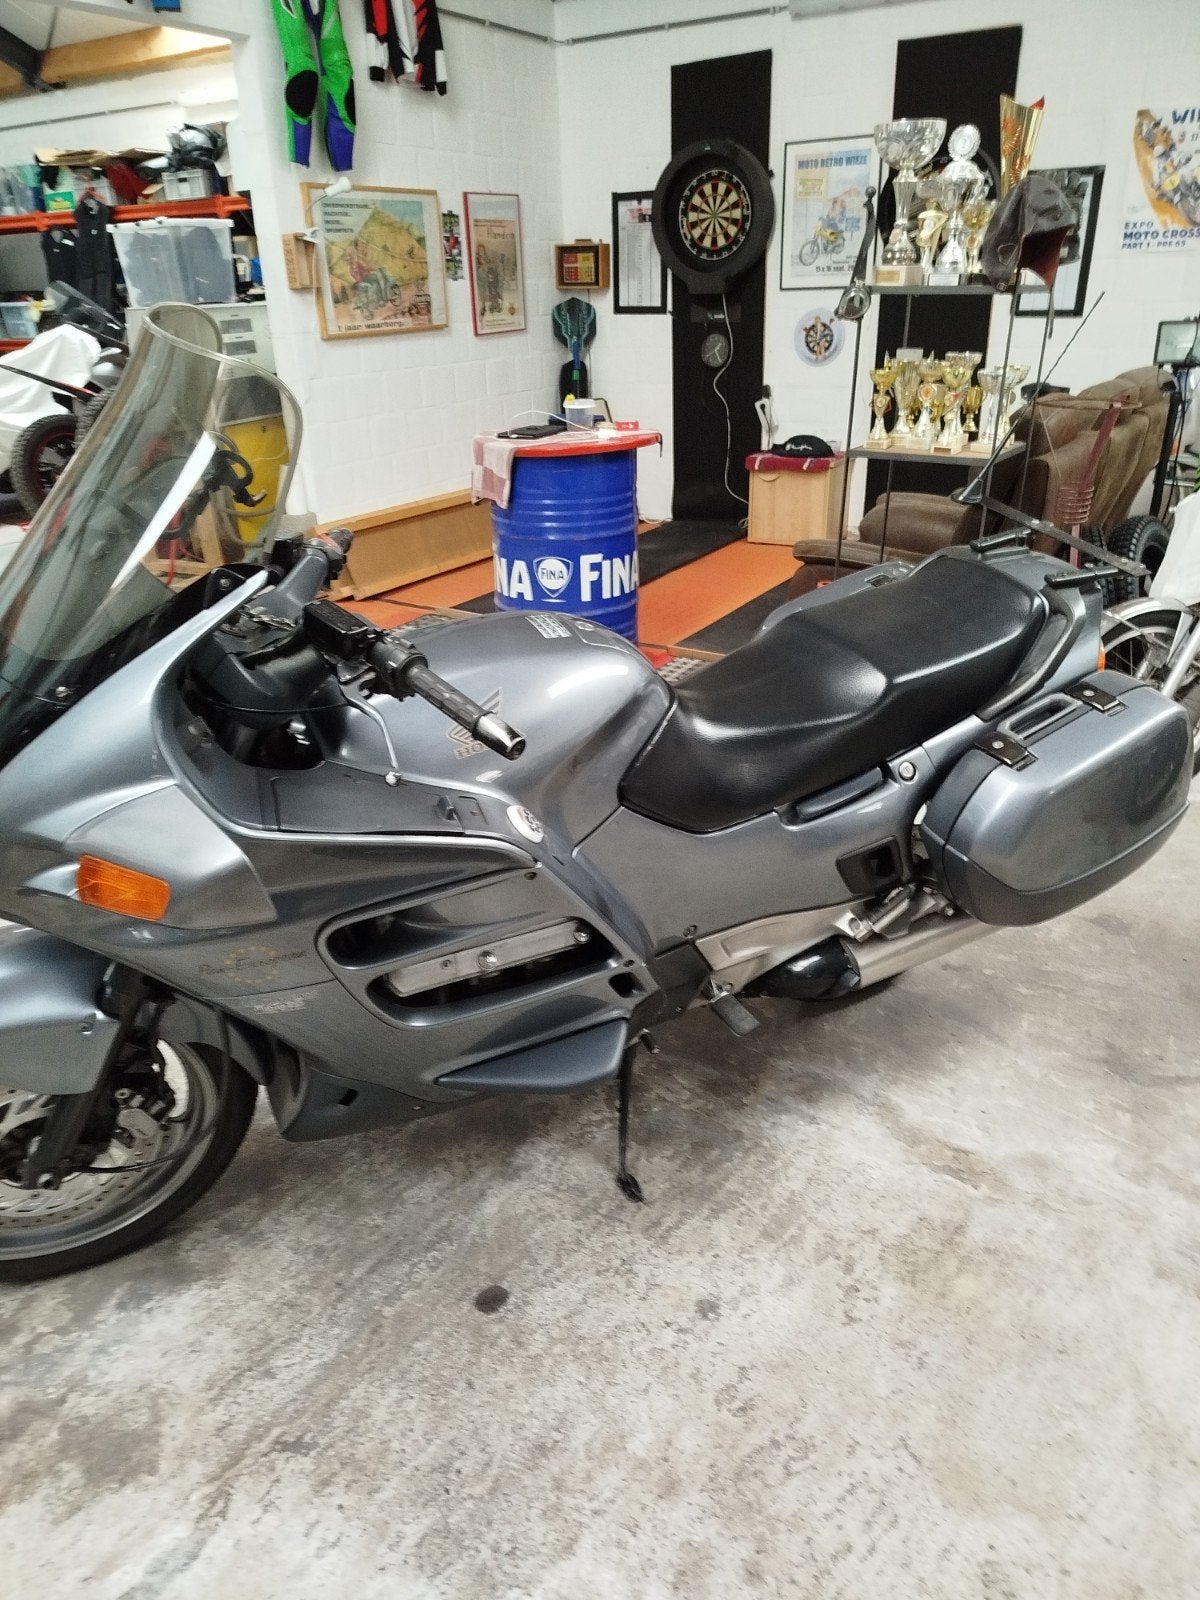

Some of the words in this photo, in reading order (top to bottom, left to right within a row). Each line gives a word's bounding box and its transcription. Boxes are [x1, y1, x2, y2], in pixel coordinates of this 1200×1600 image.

[798, 160, 819, 169] MOTO
[820, 157, 844, 168] RETRO
[1124, 221, 1154, 230] EXPO
[1123, 230, 1159, 241] MOTO
[1162, 228, 1200, 239] CROSS
[540, 567, 565, 580] FINA
[579, 550, 640, 602] FINA
